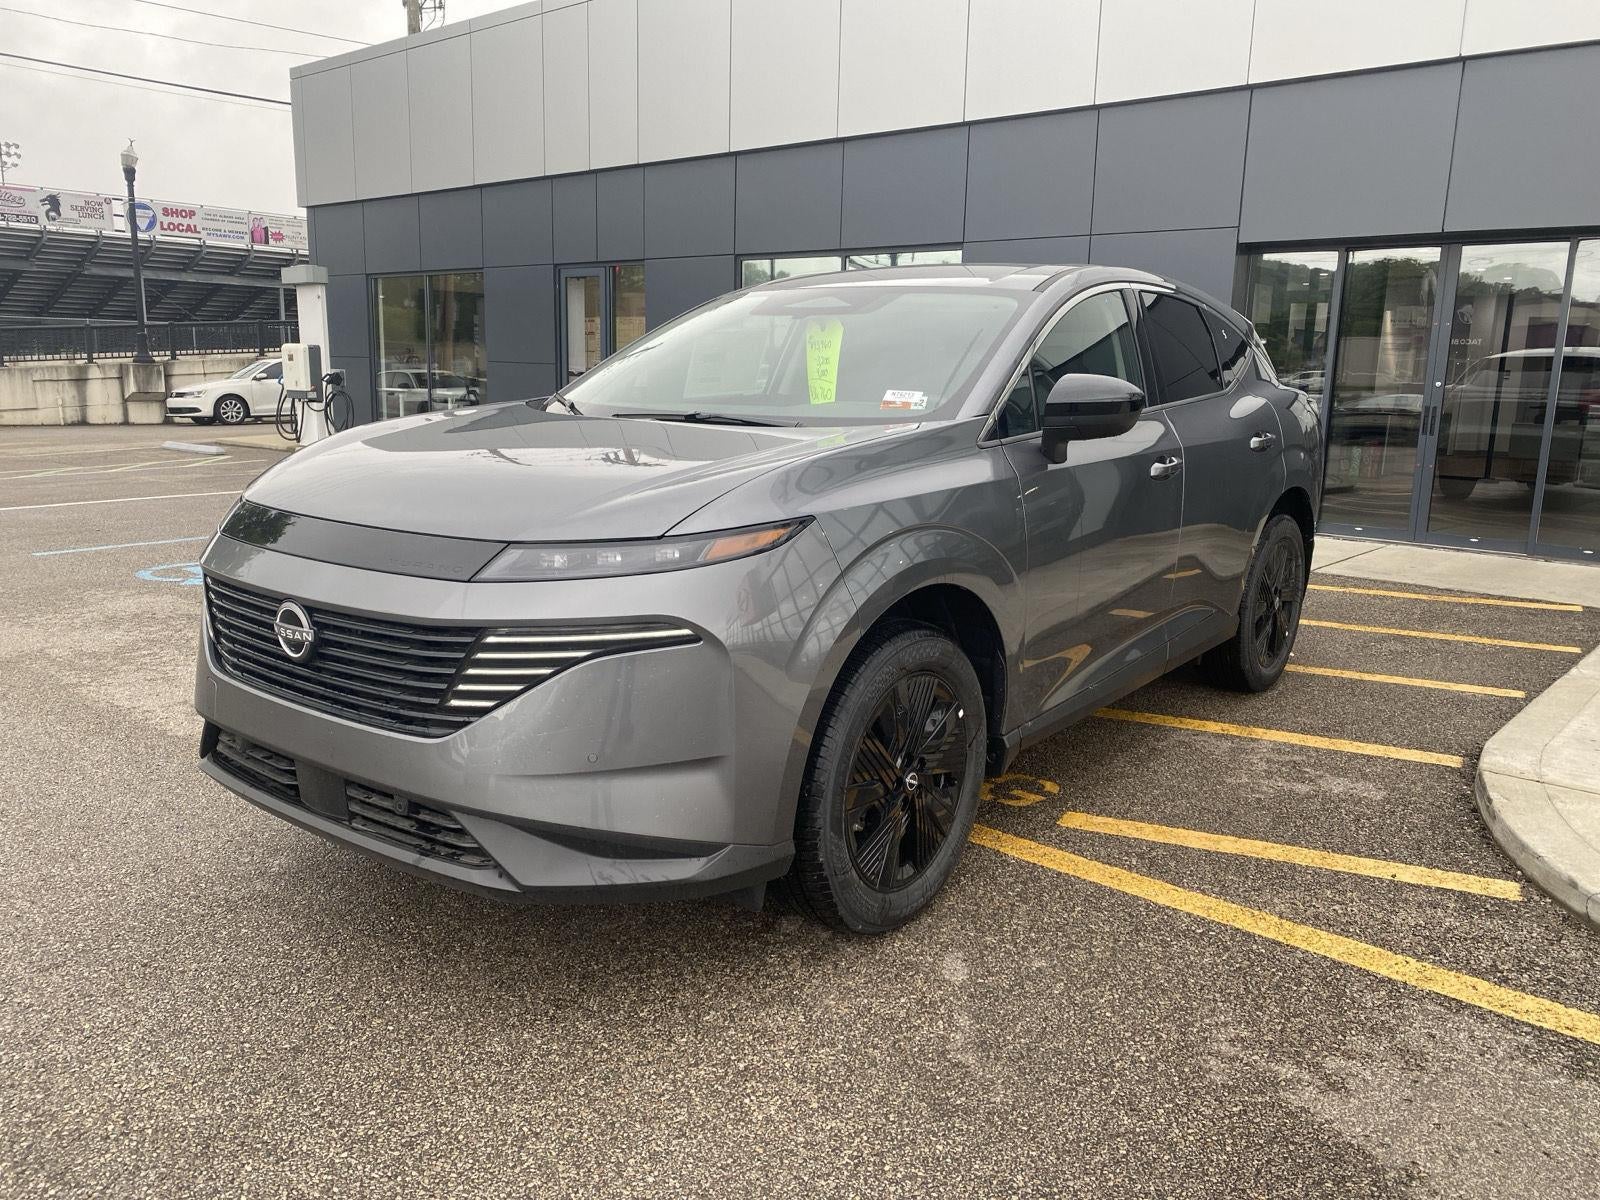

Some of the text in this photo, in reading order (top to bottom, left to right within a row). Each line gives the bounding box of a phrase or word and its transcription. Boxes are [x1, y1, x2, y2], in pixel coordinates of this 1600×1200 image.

[70, 204, 104, 214] SERVING
[161, 207, 196, 219] SHOP
[78, 211, 104, 220] LUNCH
[160, 221, 201, 234] LOCAL
